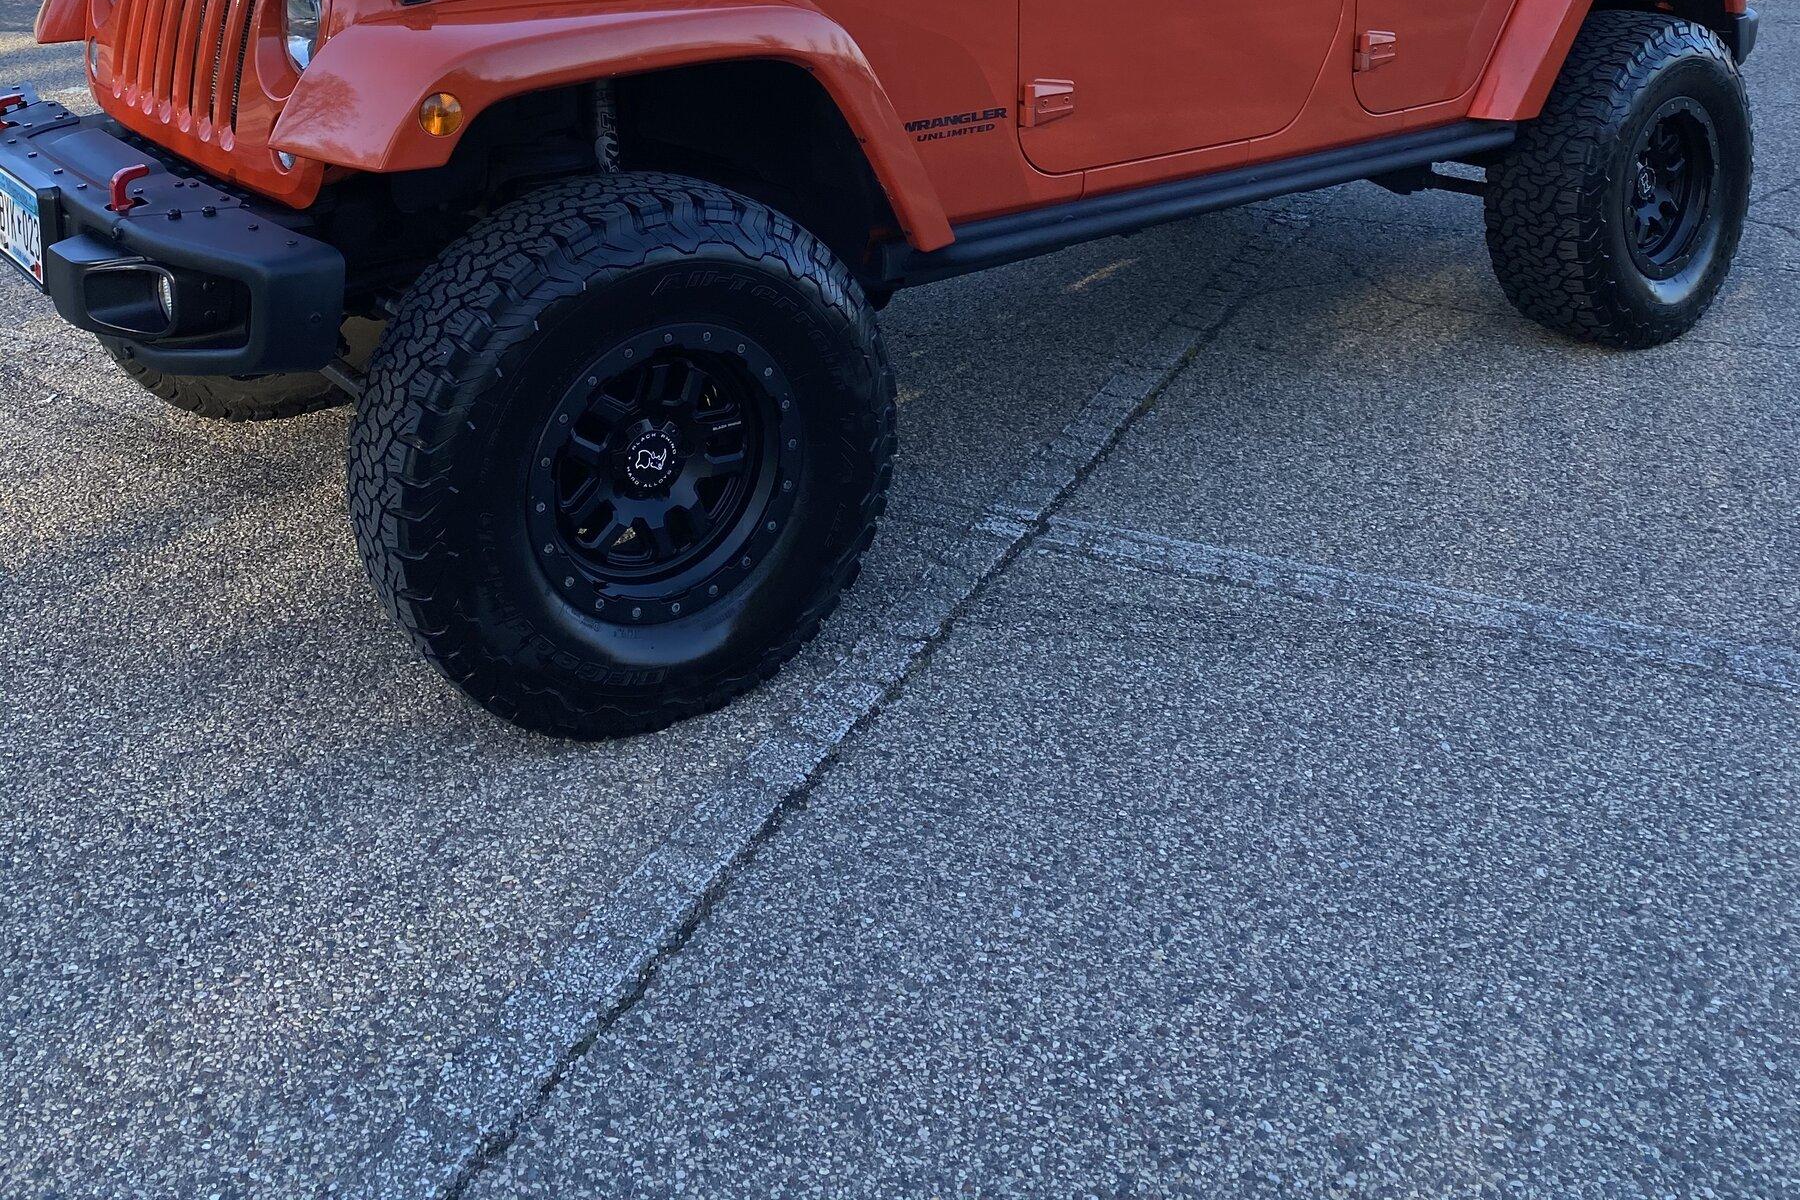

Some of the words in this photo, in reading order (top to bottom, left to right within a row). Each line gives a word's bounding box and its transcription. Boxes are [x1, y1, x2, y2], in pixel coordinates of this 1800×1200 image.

[904, 108, 1007, 132] WRANGLER
[917, 124, 995, 142] UNLIMITED
[632, 433, 656, 450] BLACK
[661, 434, 677, 455] RHINO
[627, 466, 639, 485] HARD
[643, 469, 672, 488] ALLOYS
